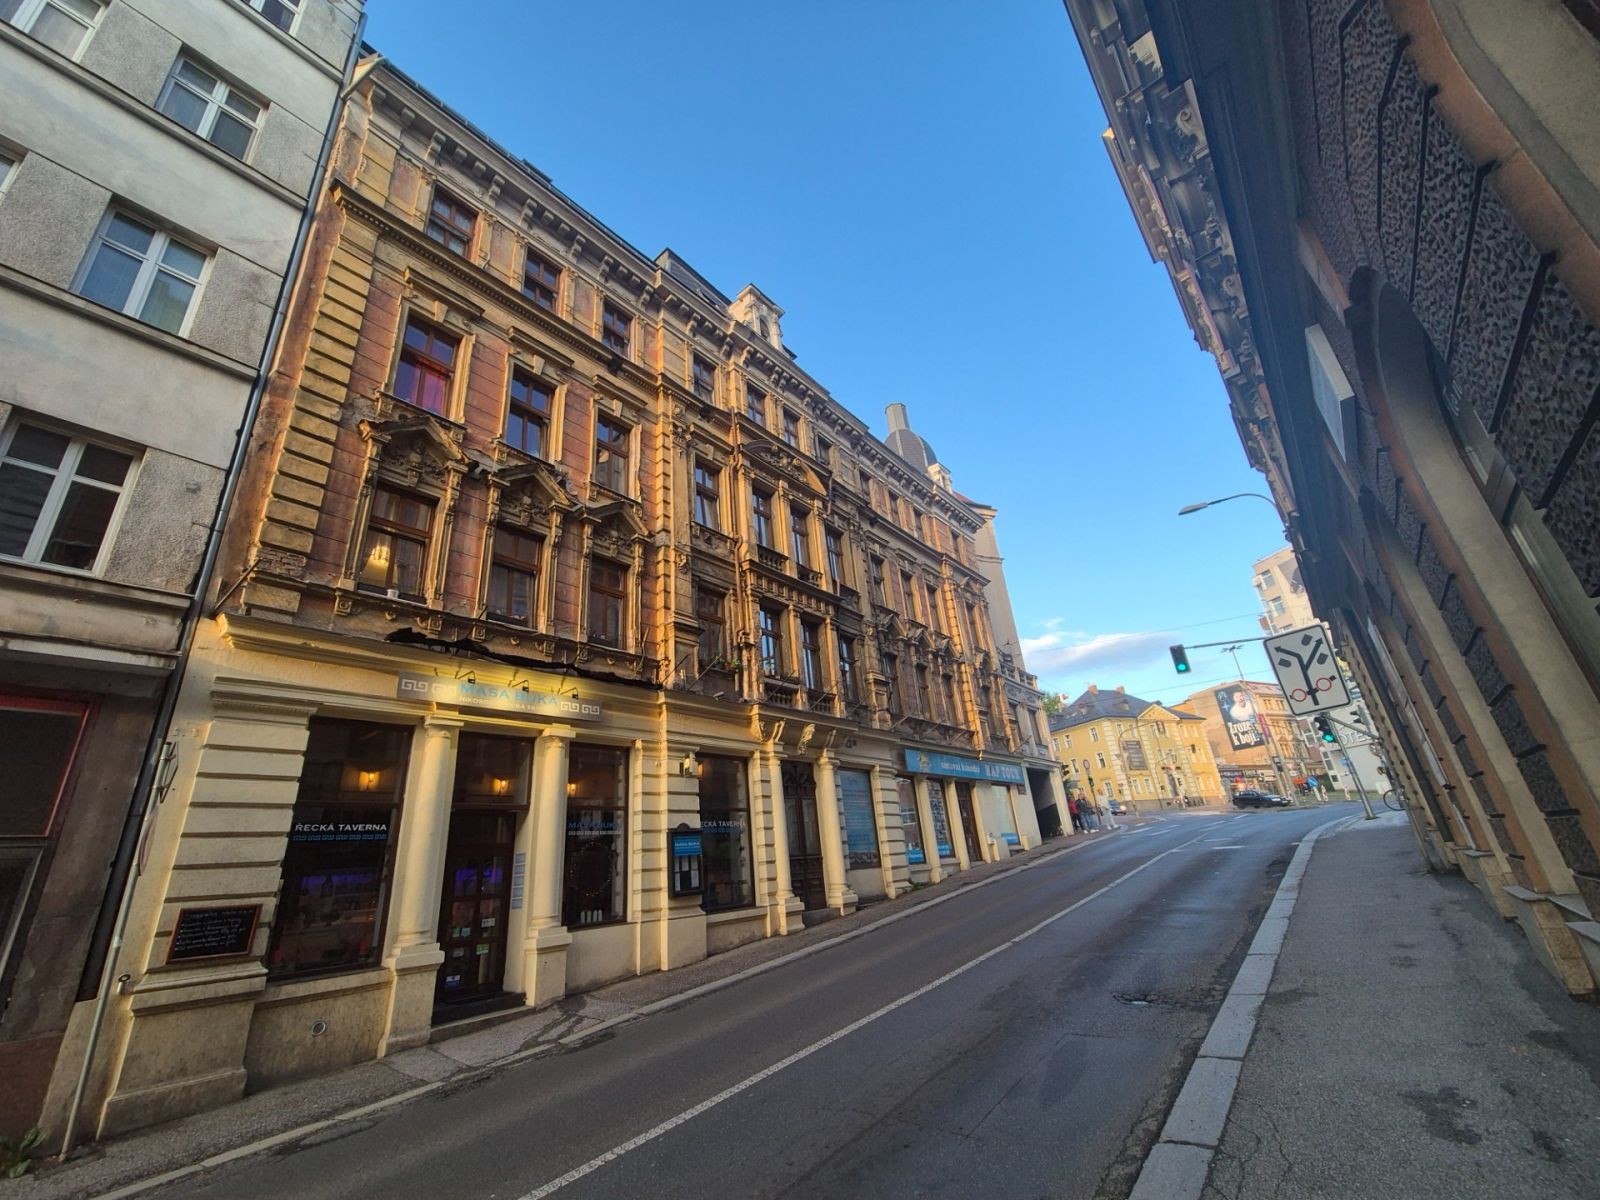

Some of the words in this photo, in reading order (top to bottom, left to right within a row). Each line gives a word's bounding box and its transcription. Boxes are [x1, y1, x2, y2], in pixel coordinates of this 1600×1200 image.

[460, 683, 509, 698] MASA
[1227, 719, 1253, 734] Zroze
[295, 822, 335, 832] ŘECKÁ
[338, 823, 387, 832] TAVERNA
[700, 820, 717, 829] ECKÁ
